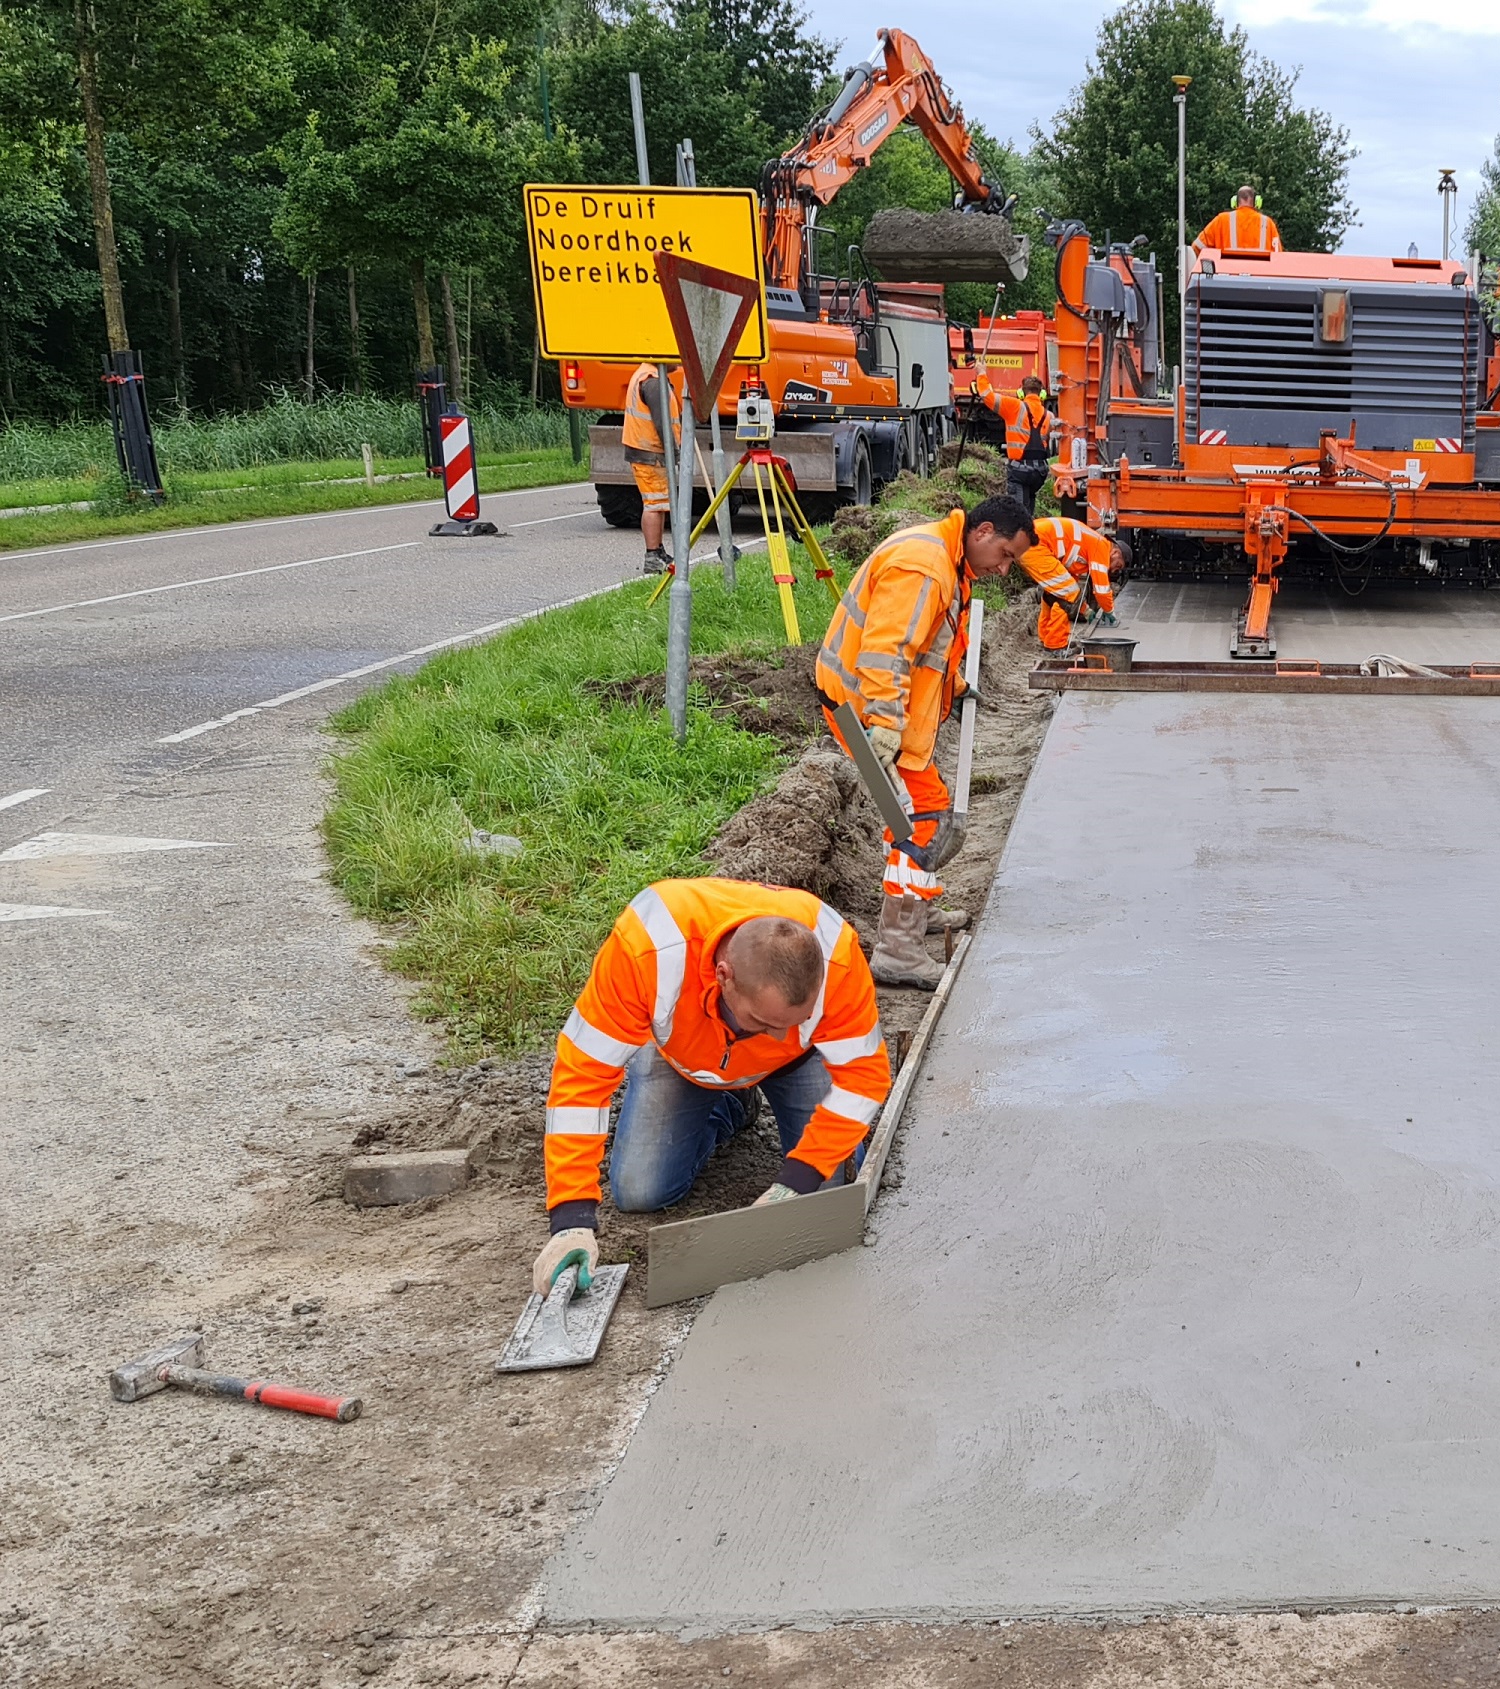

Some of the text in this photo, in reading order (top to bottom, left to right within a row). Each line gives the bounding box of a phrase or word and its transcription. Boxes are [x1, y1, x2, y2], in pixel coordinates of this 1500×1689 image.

[861, 112, 888, 145] DOOSAN
[534, 195, 656, 219] De Druif
[537, 228, 693, 252] Noordhoek
[541, 260, 661, 284] bereikba
